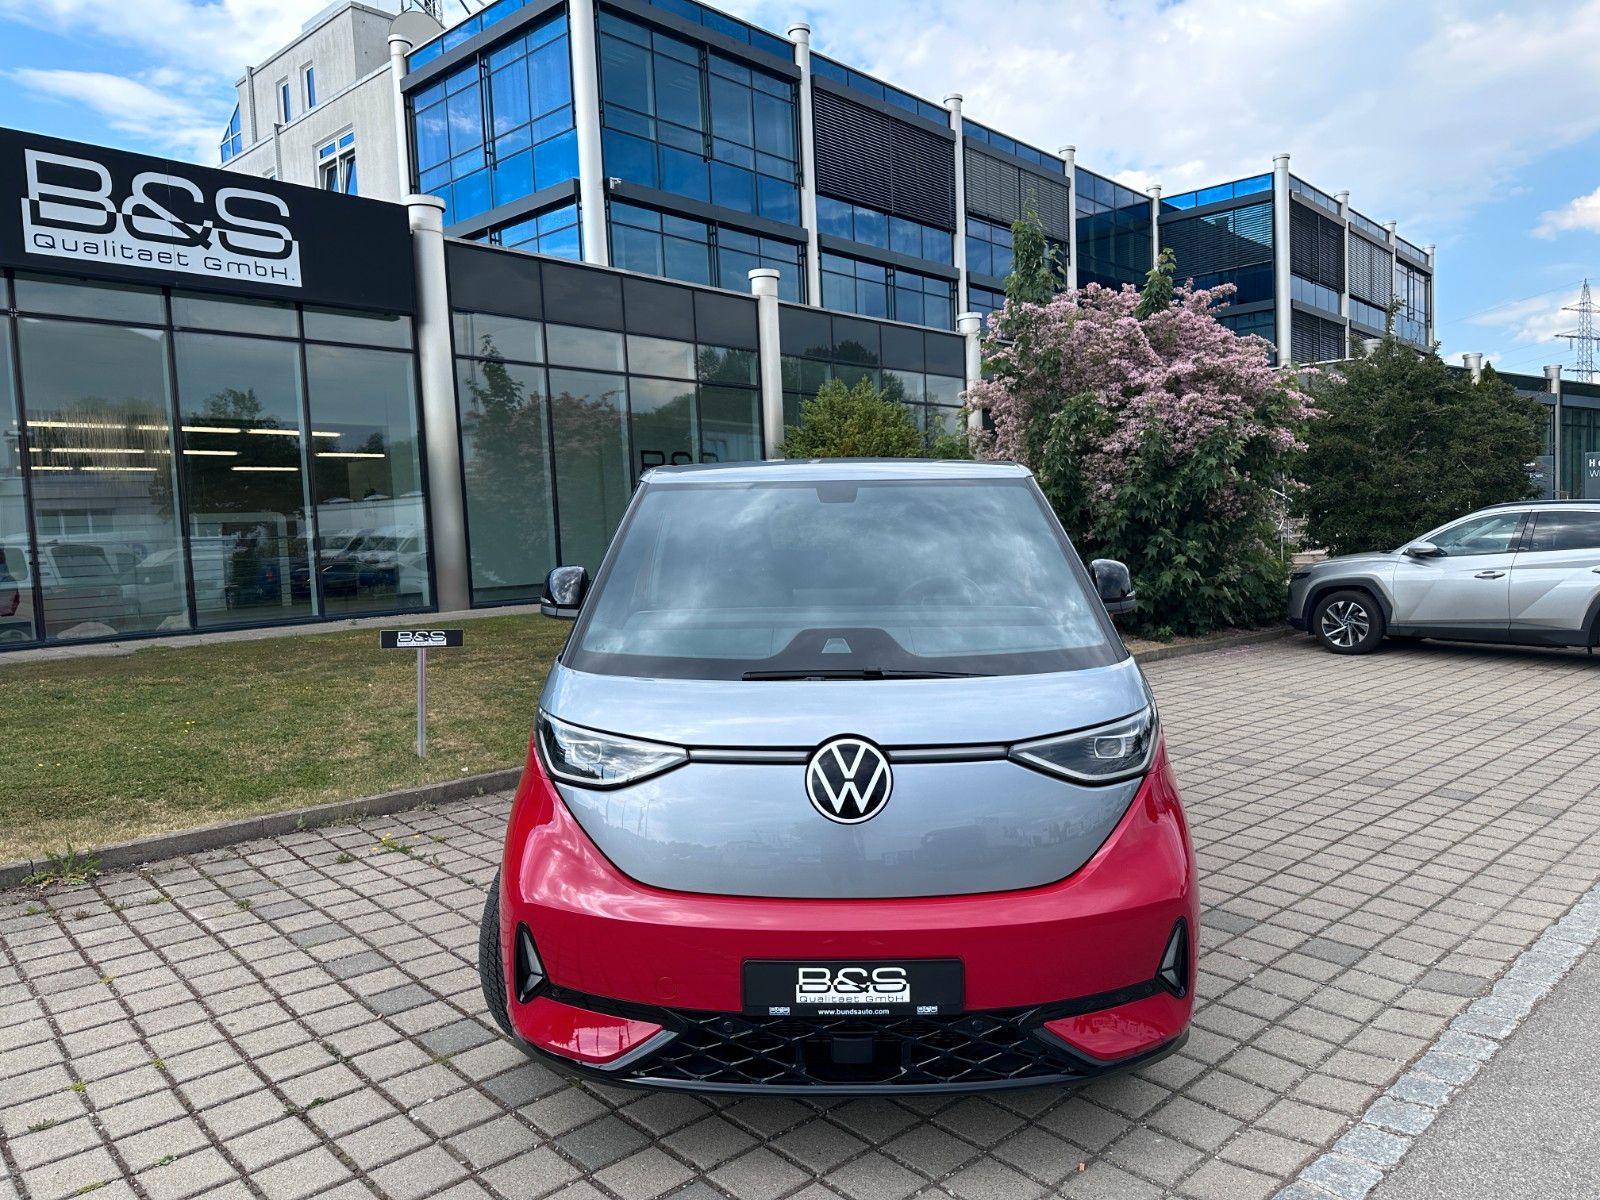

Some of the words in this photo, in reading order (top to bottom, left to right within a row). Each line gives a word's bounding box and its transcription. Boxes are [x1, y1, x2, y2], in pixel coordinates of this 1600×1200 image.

[23, 148, 293, 260] B&S
[33, 232, 189, 267] Qualitaet
[203, 255, 296, 281] GmbH.
[397, 631, 446, 643] B&S
[797, 967, 909, 994] B&S
[799, 994, 860, 1003] Qualitaet
[817, 1008, 890, 1016] www.bundsauto.com
